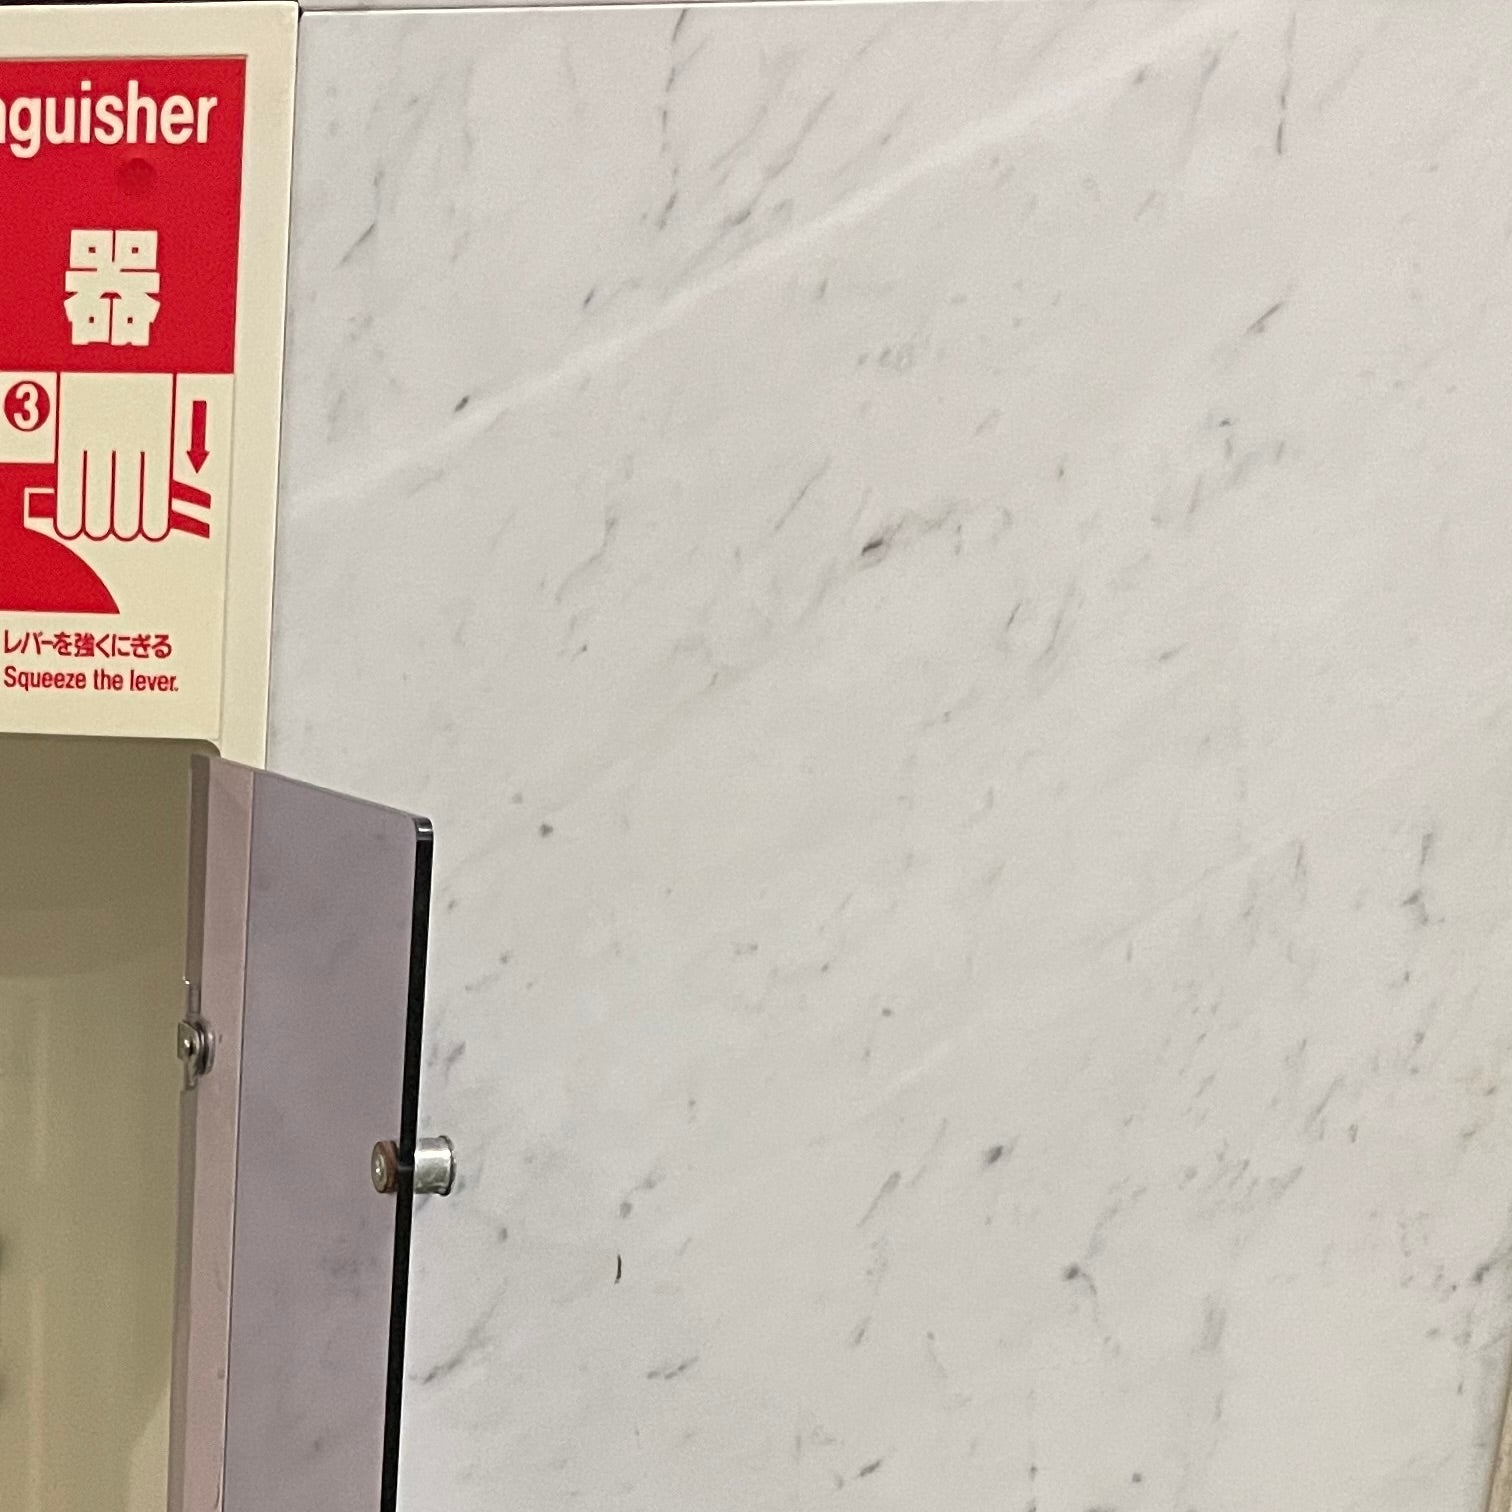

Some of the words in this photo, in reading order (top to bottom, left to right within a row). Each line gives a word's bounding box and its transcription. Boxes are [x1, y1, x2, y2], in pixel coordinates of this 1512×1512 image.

[3, 629, 173, 659] レバーを強くにぎる
[3, 665, 87, 692] Squeeze
[92, 668, 124, 691] the
[129, 669, 179, 692] lever.
